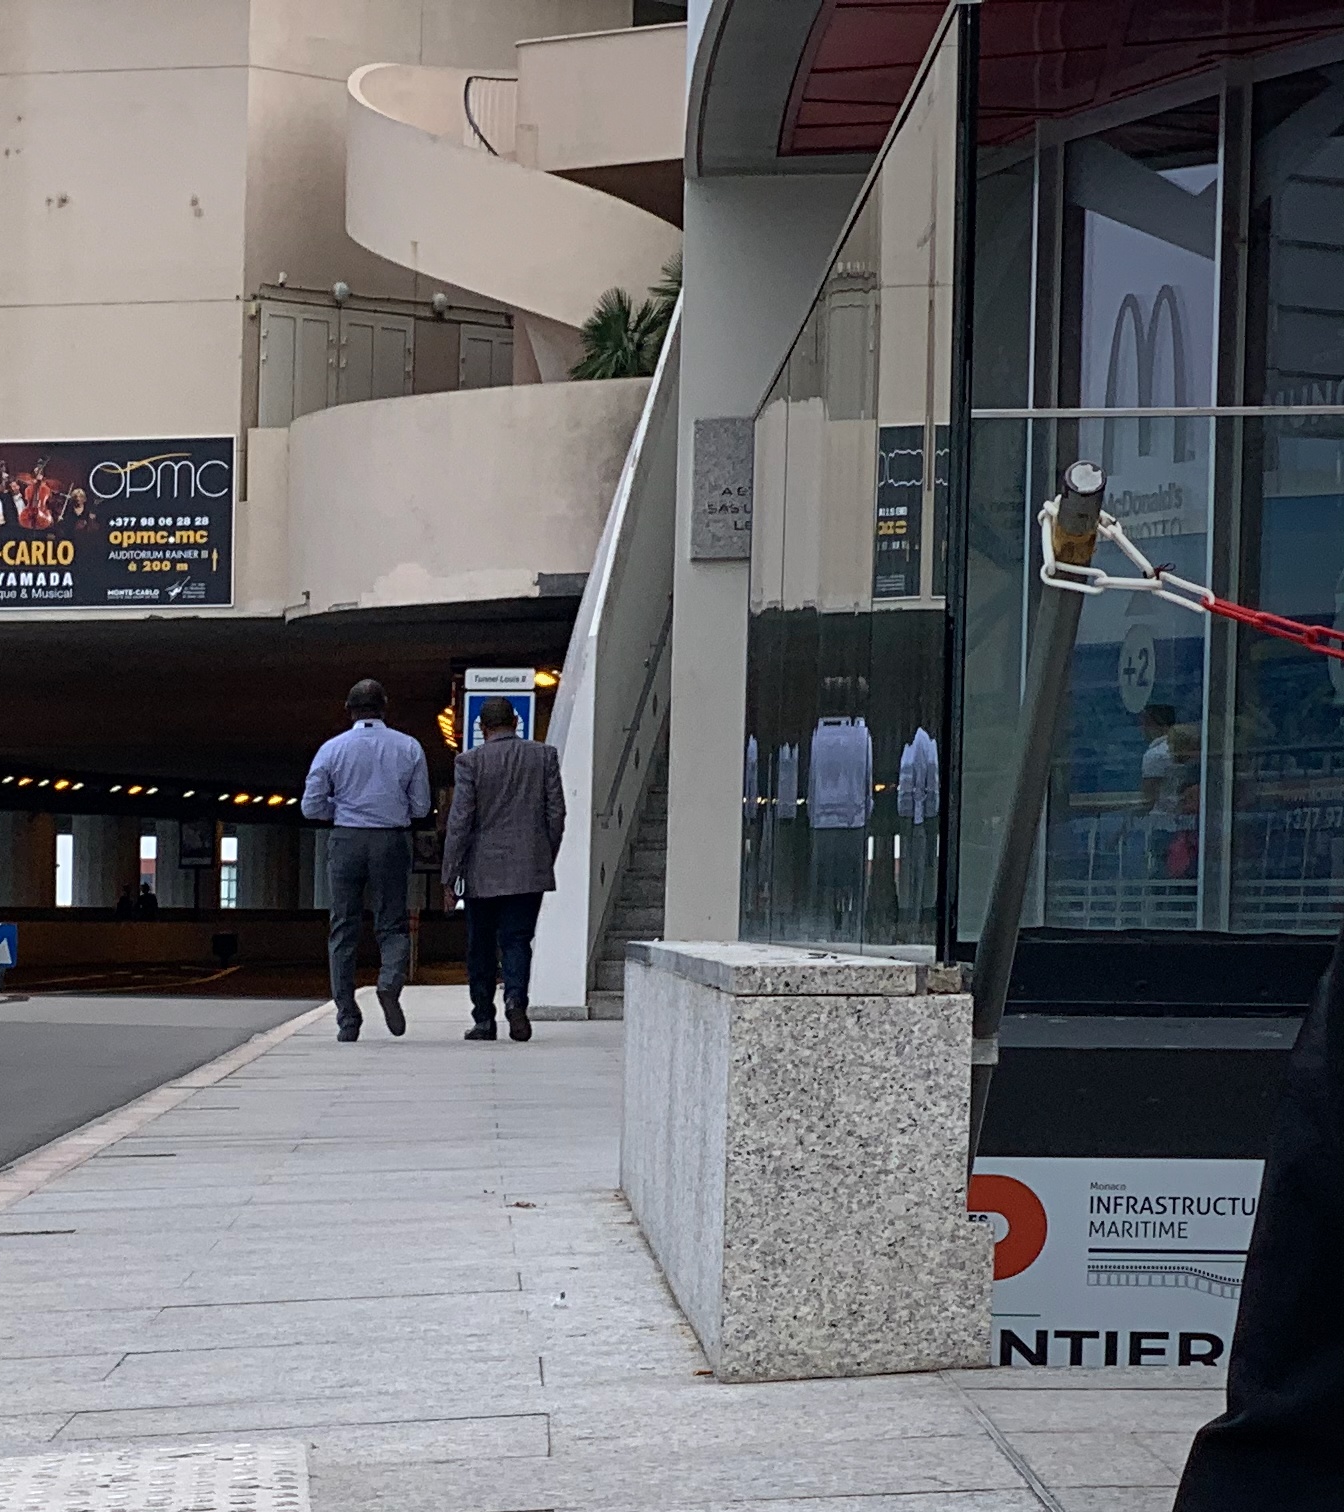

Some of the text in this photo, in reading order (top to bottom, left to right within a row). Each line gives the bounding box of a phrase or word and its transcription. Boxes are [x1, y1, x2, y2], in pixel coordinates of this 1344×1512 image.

[109, 517, 137, 527] +377
[158, 517, 173, 527] 06
[176, 517, 191, 526] 28
[194, 516, 210, 526] 28
[109, 529, 209, 548] opmc.mc
[108, 550, 164, 560] AUDITORIUM
[165, 550, 199, 560] RAINIER
[142, 560, 172, 572] 200
[175, 562, 189, 571] m
[20, 588, 29, 599] &
[31, 587, 73, 600] Musical
[474, 674, 499, 683] Tunnel
[499, 675, 520, 684] Louis
[1090, 1182, 1127, 1191] Monaco
[1089, 1220, 1189, 1239] MARITIME
